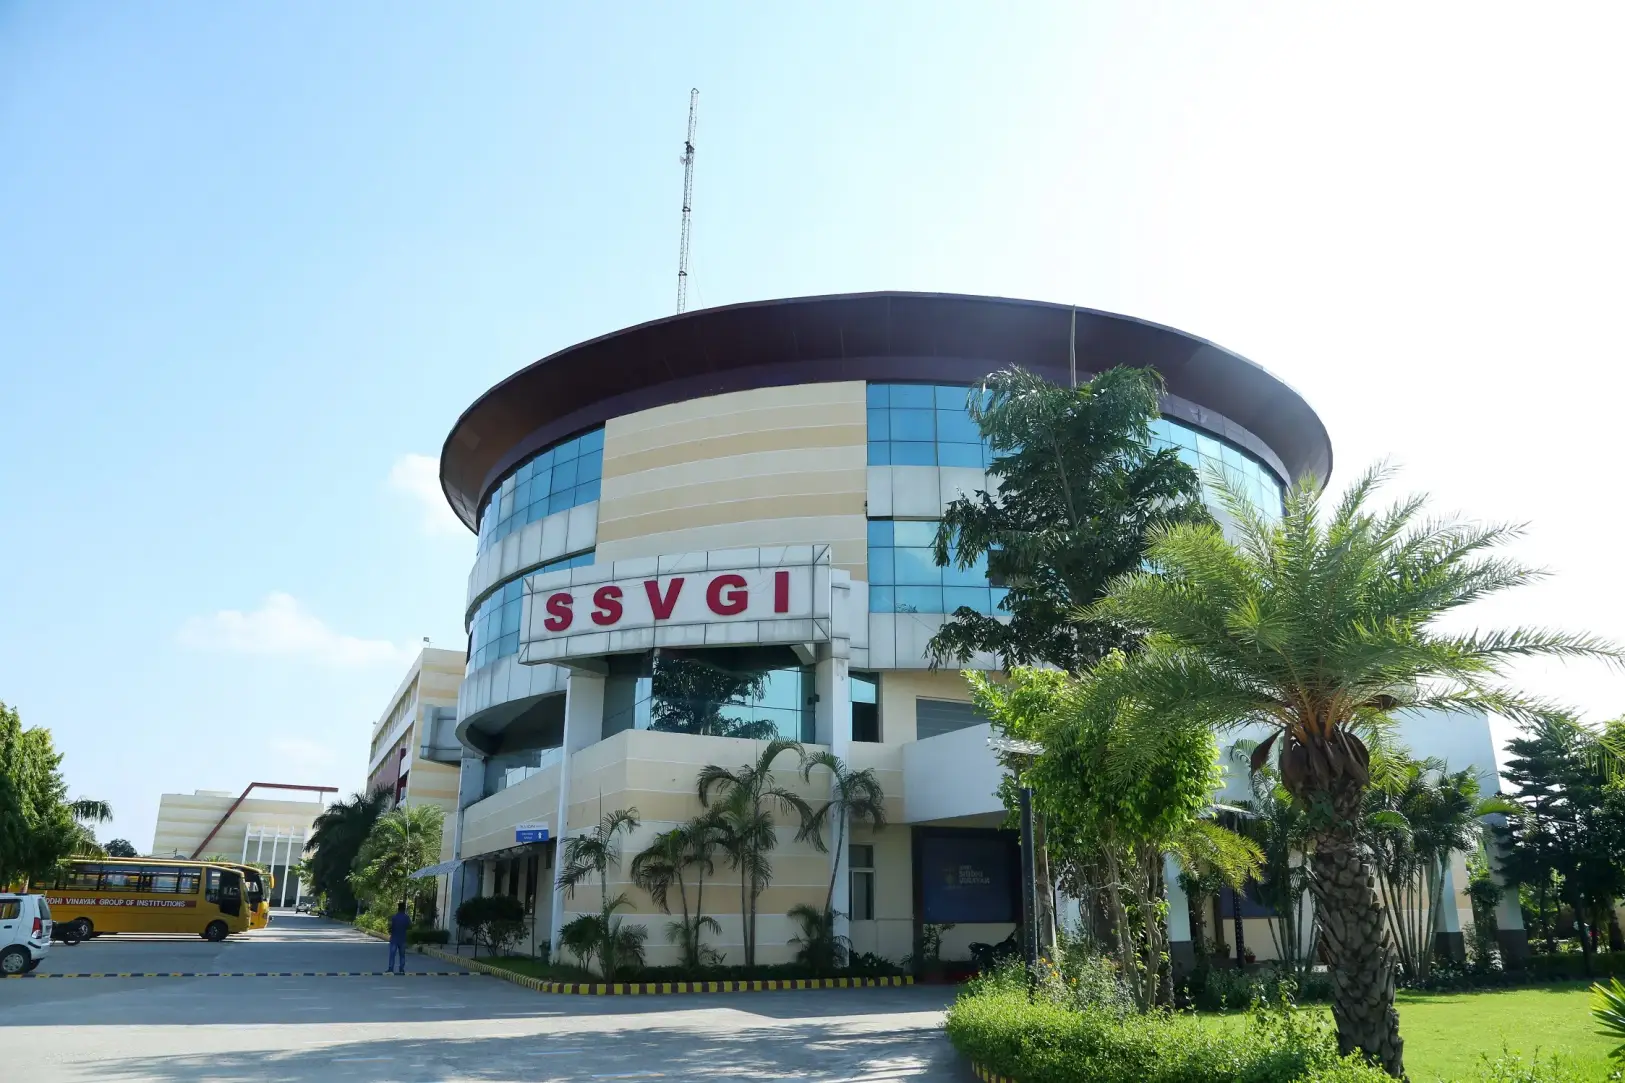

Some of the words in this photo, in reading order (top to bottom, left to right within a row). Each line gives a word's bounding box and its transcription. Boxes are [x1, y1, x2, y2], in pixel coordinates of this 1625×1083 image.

[66, 897, 96, 905] VINAYAK
[99, 898, 124, 906] GROUP
[136, 899, 186, 908] INSTITUTIONS
